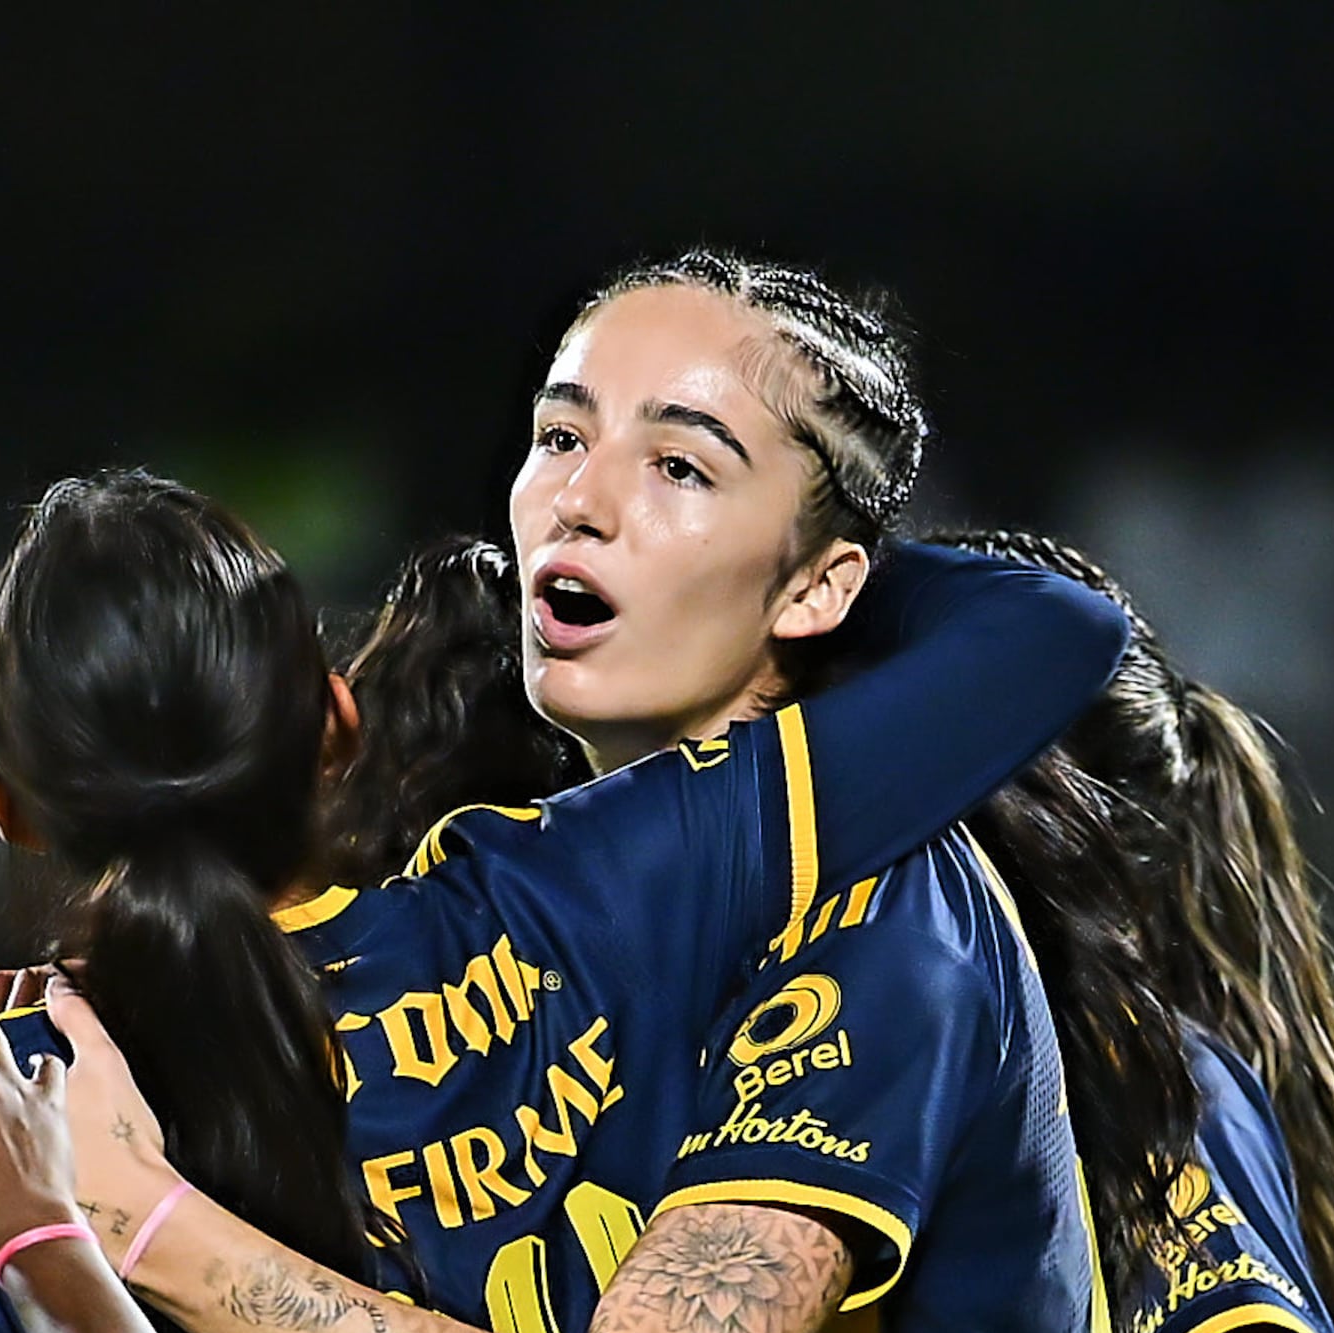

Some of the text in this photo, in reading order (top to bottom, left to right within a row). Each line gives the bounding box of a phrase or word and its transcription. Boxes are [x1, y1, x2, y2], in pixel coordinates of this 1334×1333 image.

[733, 1029, 852, 1103] Berel
[361, 1015, 624, 1248] FIRME
[714, 1102, 871, 1162] Hortons
